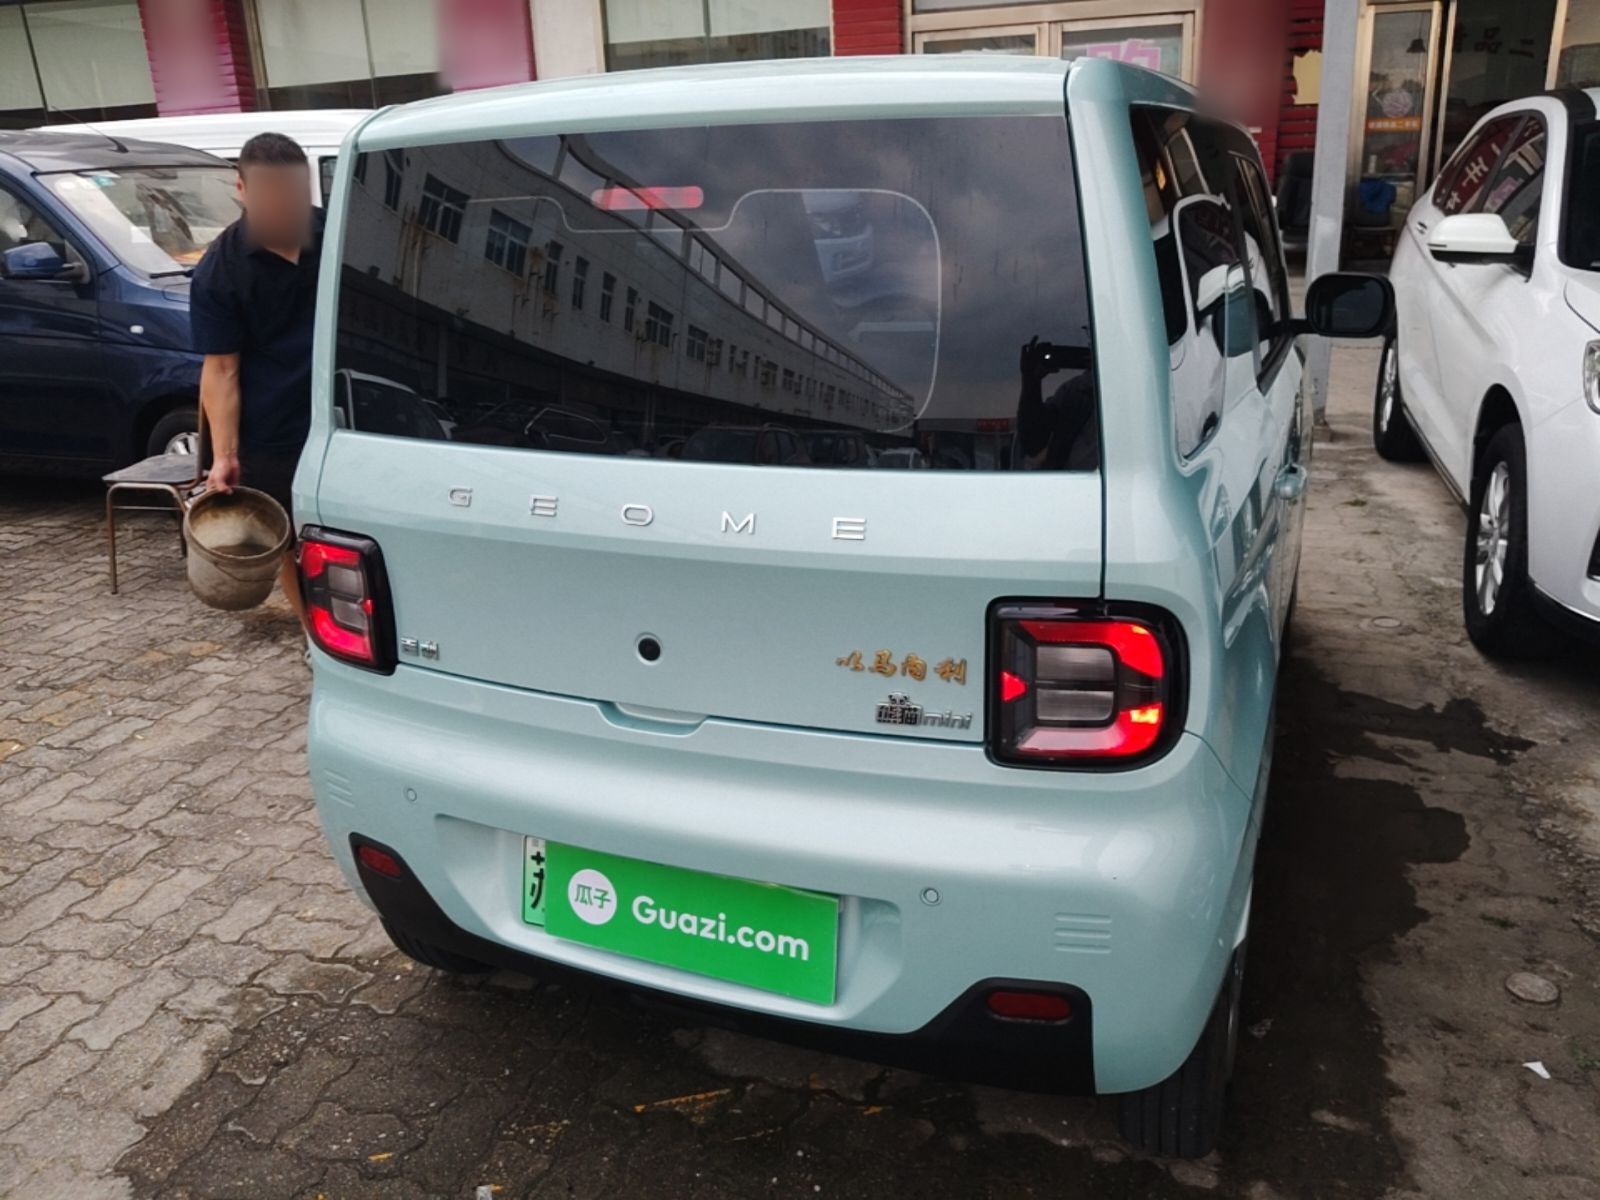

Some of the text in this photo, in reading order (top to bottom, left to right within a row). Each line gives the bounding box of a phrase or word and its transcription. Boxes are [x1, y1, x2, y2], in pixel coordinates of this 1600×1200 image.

[448, 486, 867, 541] GEOME
[574, 882, 810, 961] 瓜子 Guazi.com
